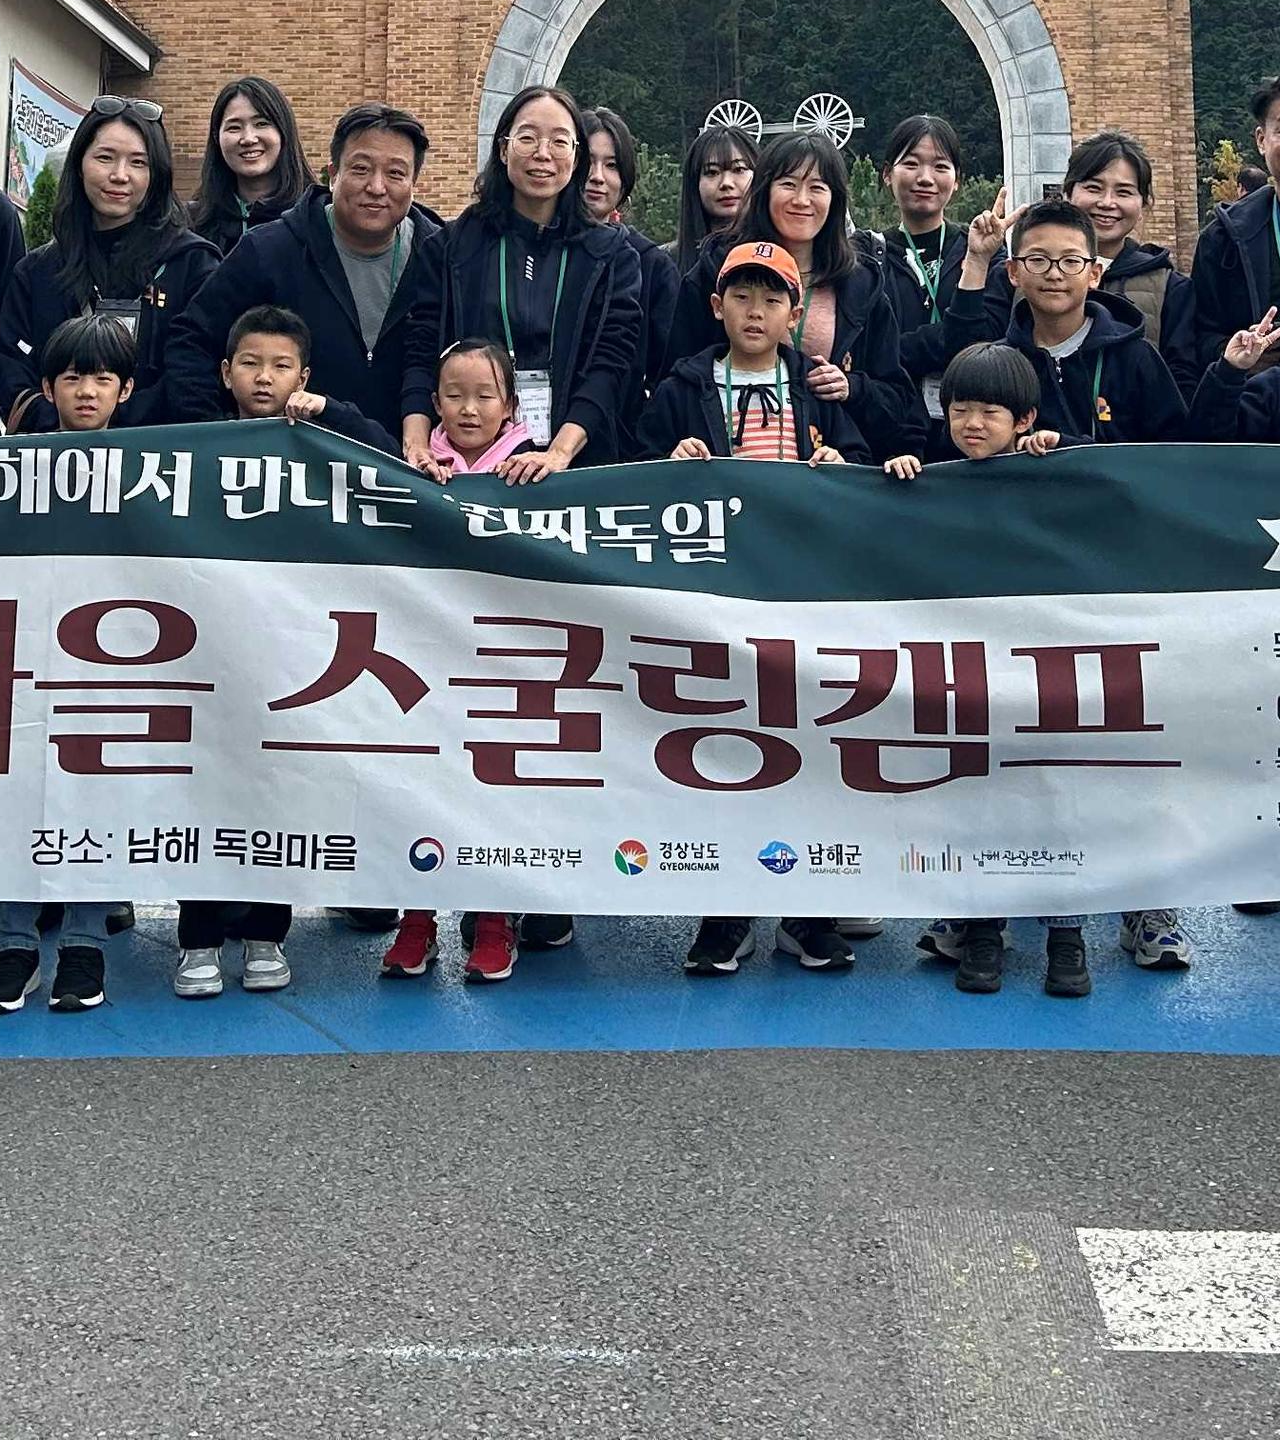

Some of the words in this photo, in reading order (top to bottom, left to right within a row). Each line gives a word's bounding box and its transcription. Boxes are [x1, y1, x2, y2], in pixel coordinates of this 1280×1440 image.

[218, 455, 418, 529] 만나는
[260, 610, 1183, 793] 스쿨링캠프
[29, 828, 114, 866] 장소:
[127, 826, 200, 864] 남해
[212, 827, 358, 872] 독일마을
[456, 846, 583, 868] 문화체육관광부
[658, 841, 721, 860] 경상남도
[806, 842, 862, 866] 남해군
[658, 861, 721, 872] GYEONGNAM
